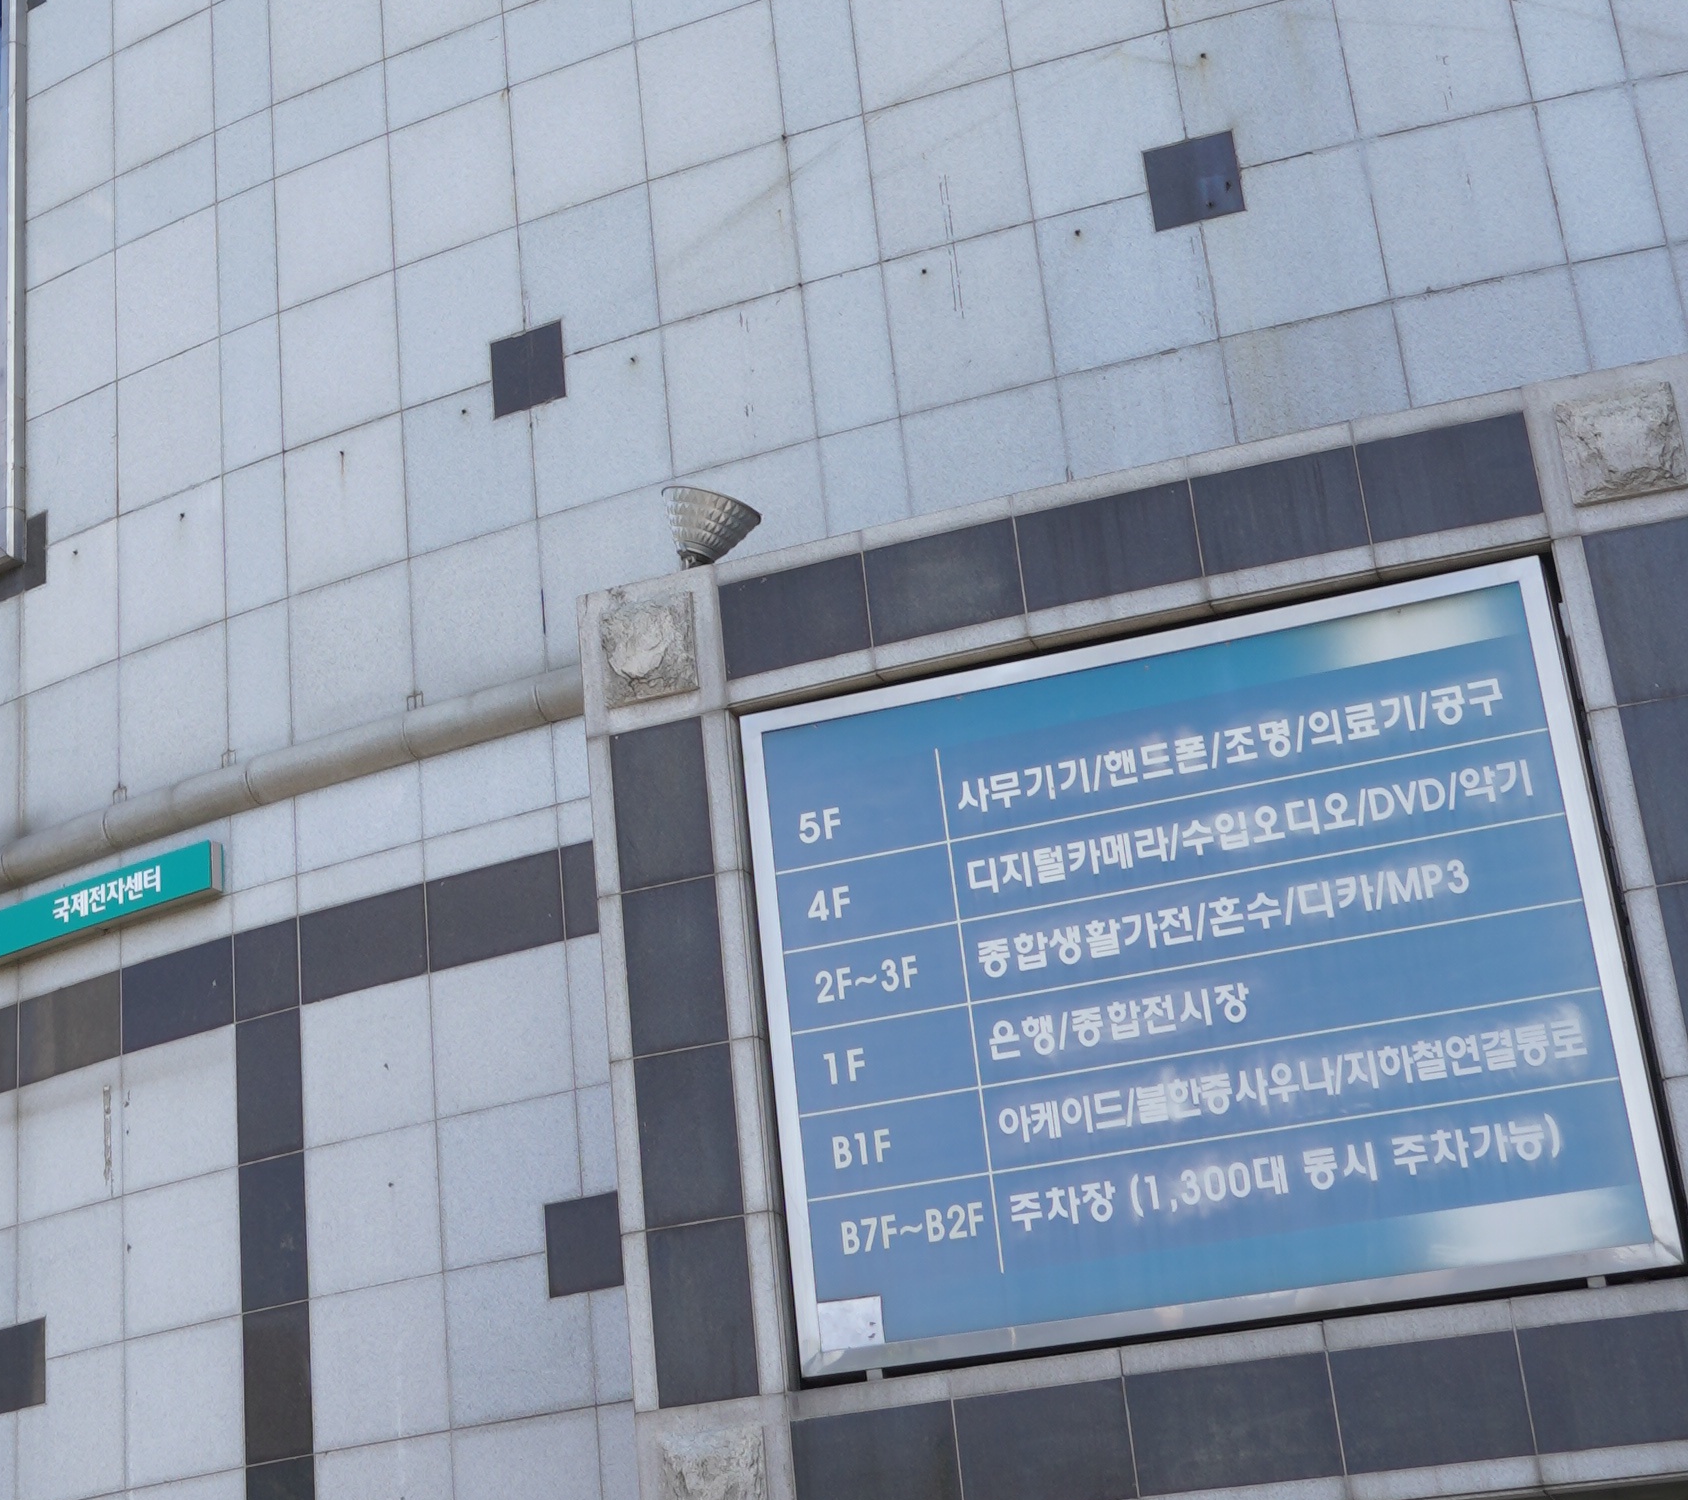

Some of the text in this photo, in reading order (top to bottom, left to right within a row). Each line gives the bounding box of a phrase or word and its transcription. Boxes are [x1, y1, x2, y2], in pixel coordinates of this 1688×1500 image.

[798, 807, 841, 844] 5F
[52, 865, 161, 923] 국제전자센터
[807, 885, 851, 922] 4F
[815, 955, 918, 1004] 2F~3F
[823, 1047, 866, 1085] 1F
[832, 1128, 891, 1170] B1F
[841, 1202, 984, 1255] B7F~B2F
[1010, 1181, 1116, 1232] 주차장
[1302, 1141, 1378, 1190] 동시
[1391, 1113, 1562, 1176] 주차가능)
